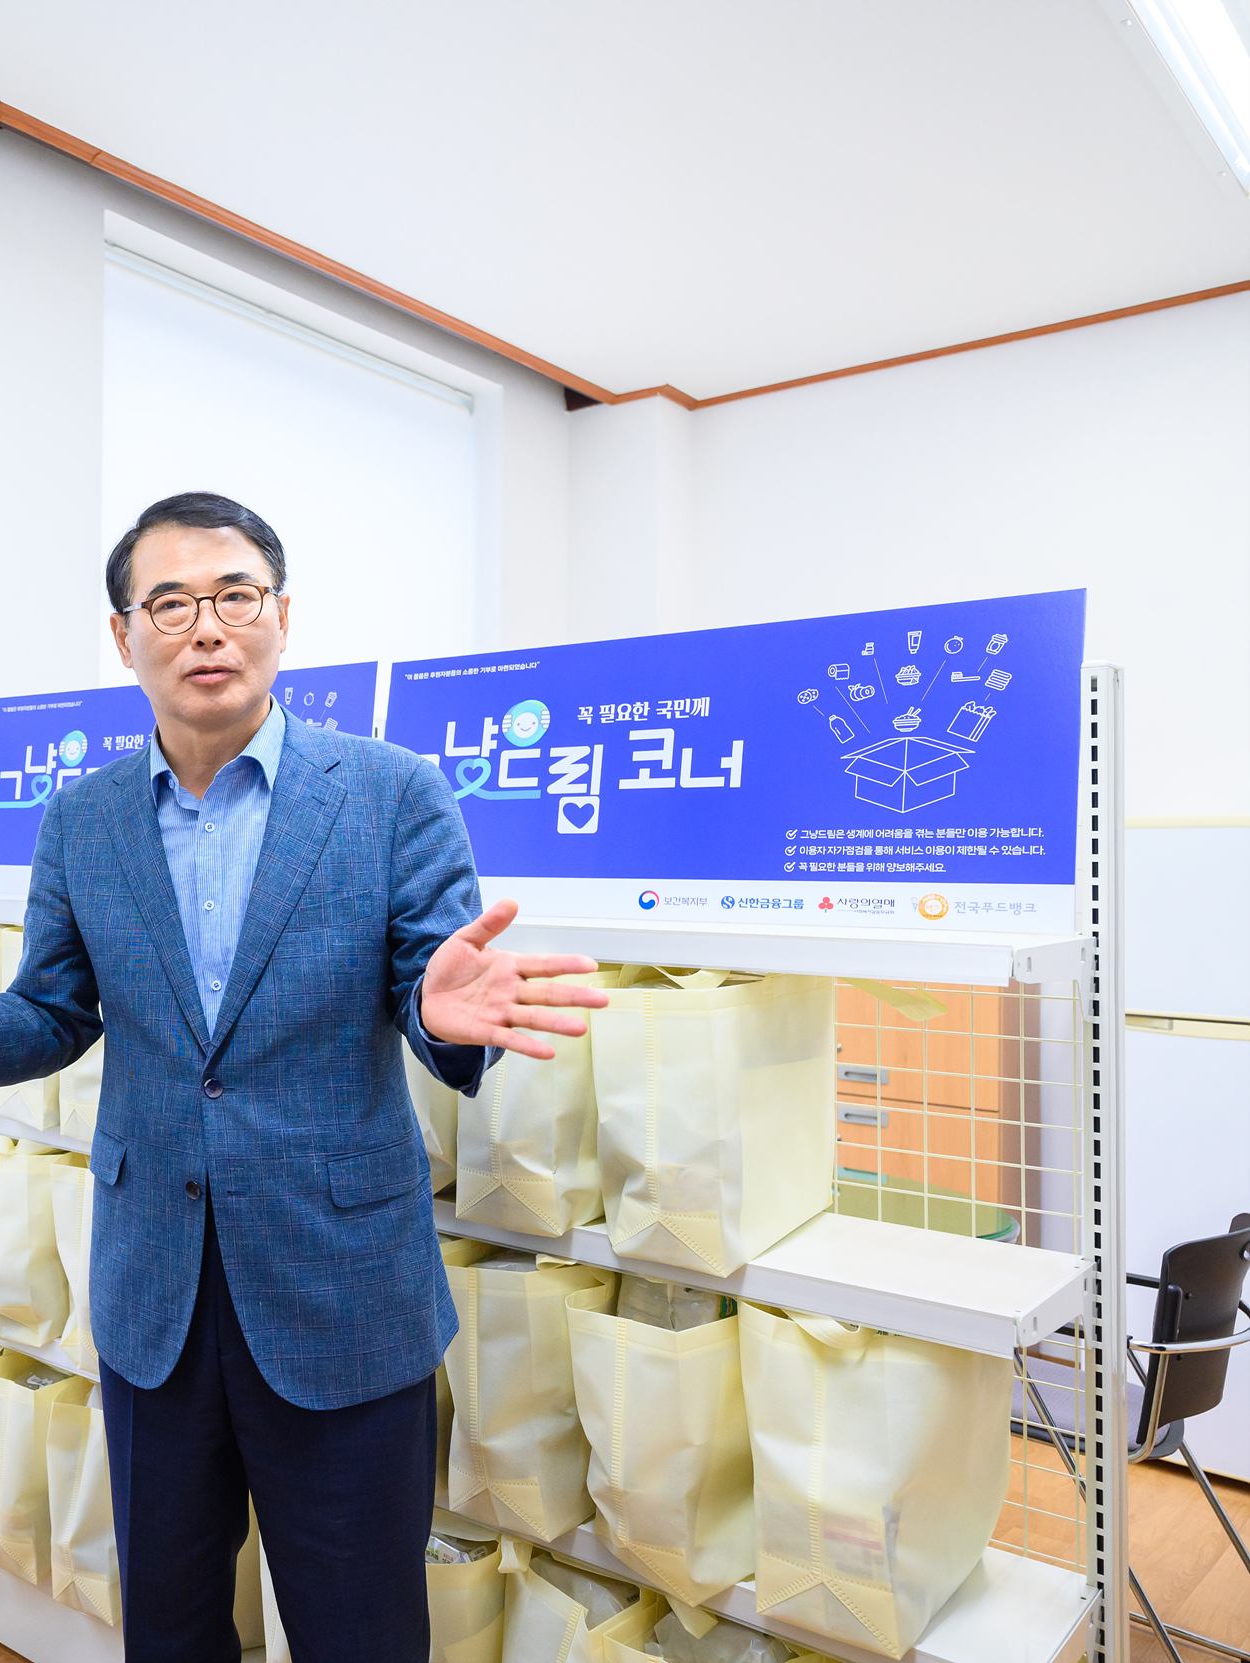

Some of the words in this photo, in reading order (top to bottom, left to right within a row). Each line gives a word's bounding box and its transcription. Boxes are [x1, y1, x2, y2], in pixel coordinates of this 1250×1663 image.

[577, 706, 593, 725] 꼭
[599, 701, 651, 724] 필요한
[655, 696, 711, 721] 국민께
[102, 736, 113, 751] 꼭
[115, 734, 144, 750] 필요한
[417, 699, 604, 834] 냥드림
[618, 727, 745, 790] 코너
[800, 828, 846, 840] 그냥드림은
[846, 828, 874, 839] 생계에
[875, 828, 914, 839] 어려움을
[915, 828, 935, 839] 겪는
[935, 827, 966, 839] 분들만
[967, 828, 989, 838] 이용
[989, 826, 1045, 838] 가능합니다.
[799, 845, 827, 856] 이용자
[827, 845, 873, 856] 자가점검을
[874, 845, 894, 856] 통해
[894, 845, 924, 856] 서비스
[925, 845, 955, 856] 이용이
[956, 845, 988, 856] 제한될
[988, 845, 1000, 856] 수
[1001, 845, 1046, 856] 있습니다.
[798, 861, 808, 873] 꼭
[809, 862, 836, 873] 필요한
[836, 862, 865, 873] 분들을
[865, 862, 885, 873] 위해
[886, 862, 947, 873] 양보해주세요.
[664, 896, 709, 908] 보건복지부
[737, 897, 805, 910] 신한금융그룹
[836, 897, 895, 910] 사랑의열매
[954, 900, 1037, 916] 전국푸드뱅크
